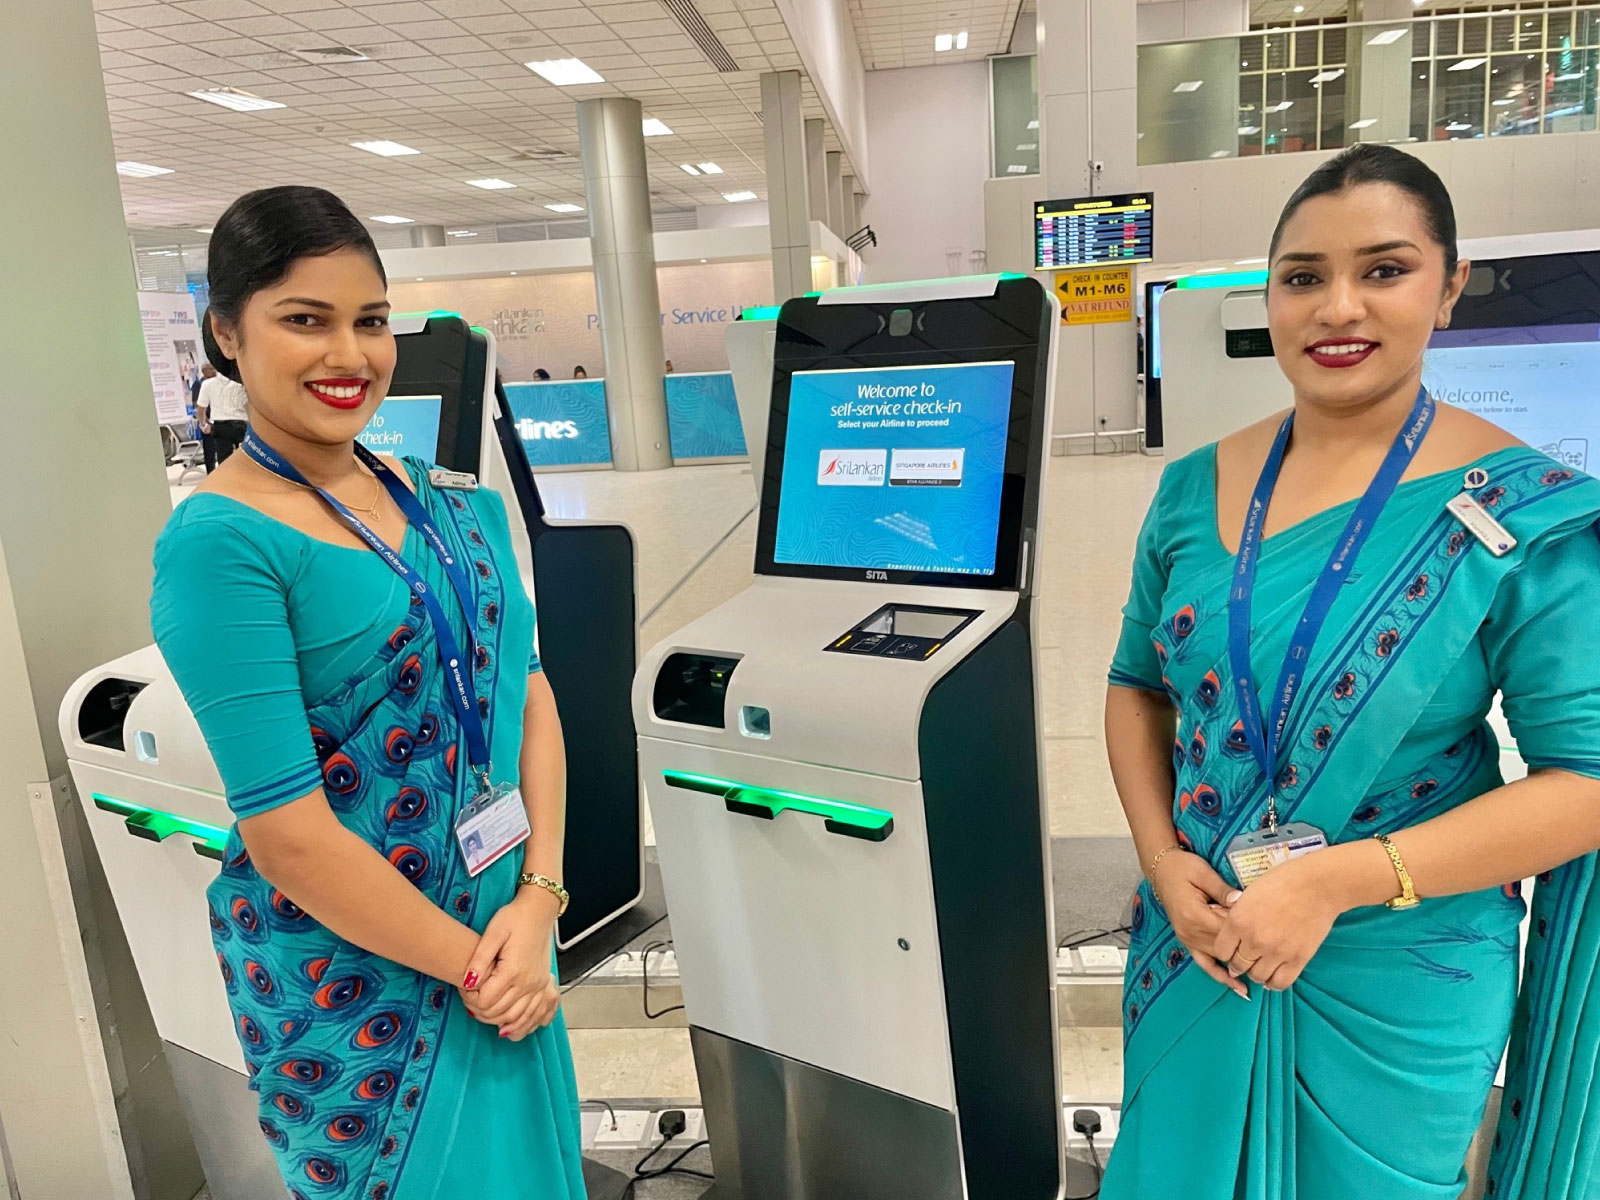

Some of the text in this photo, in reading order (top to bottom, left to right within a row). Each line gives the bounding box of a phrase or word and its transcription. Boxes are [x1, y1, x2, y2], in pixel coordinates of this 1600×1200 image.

[1102, 272, 1129, 281] COUNTER
[1075, 284, 1126, 296] M1-M6
[1070, 300, 1130, 313] VAT REFUND
[672, 308, 727, 325] Service
[858, 382, 935, 399] Welcome to
[830, 399, 962, 417] self-service check-in
[373, 413, 384, 428] to
[838, 418, 949, 429] Select your Airline to proceed
[361, 430, 403, 445] check-in
[836, 460, 884, 475] SriLankan
[384, 550, 409, 575] Airlines
[1239, 545, 1251, 575] Airlines
[866, 570, 888, 580] SITA
[887, 563, 924, 571] Experience
[933, 565, 954, 573] faster
[957, 567, 970, 575] way
[983, 568, 994, 576] fly
[453, 668, 470, 710] srilankan.com
[1282, 673, 1297, 705] Airlines
